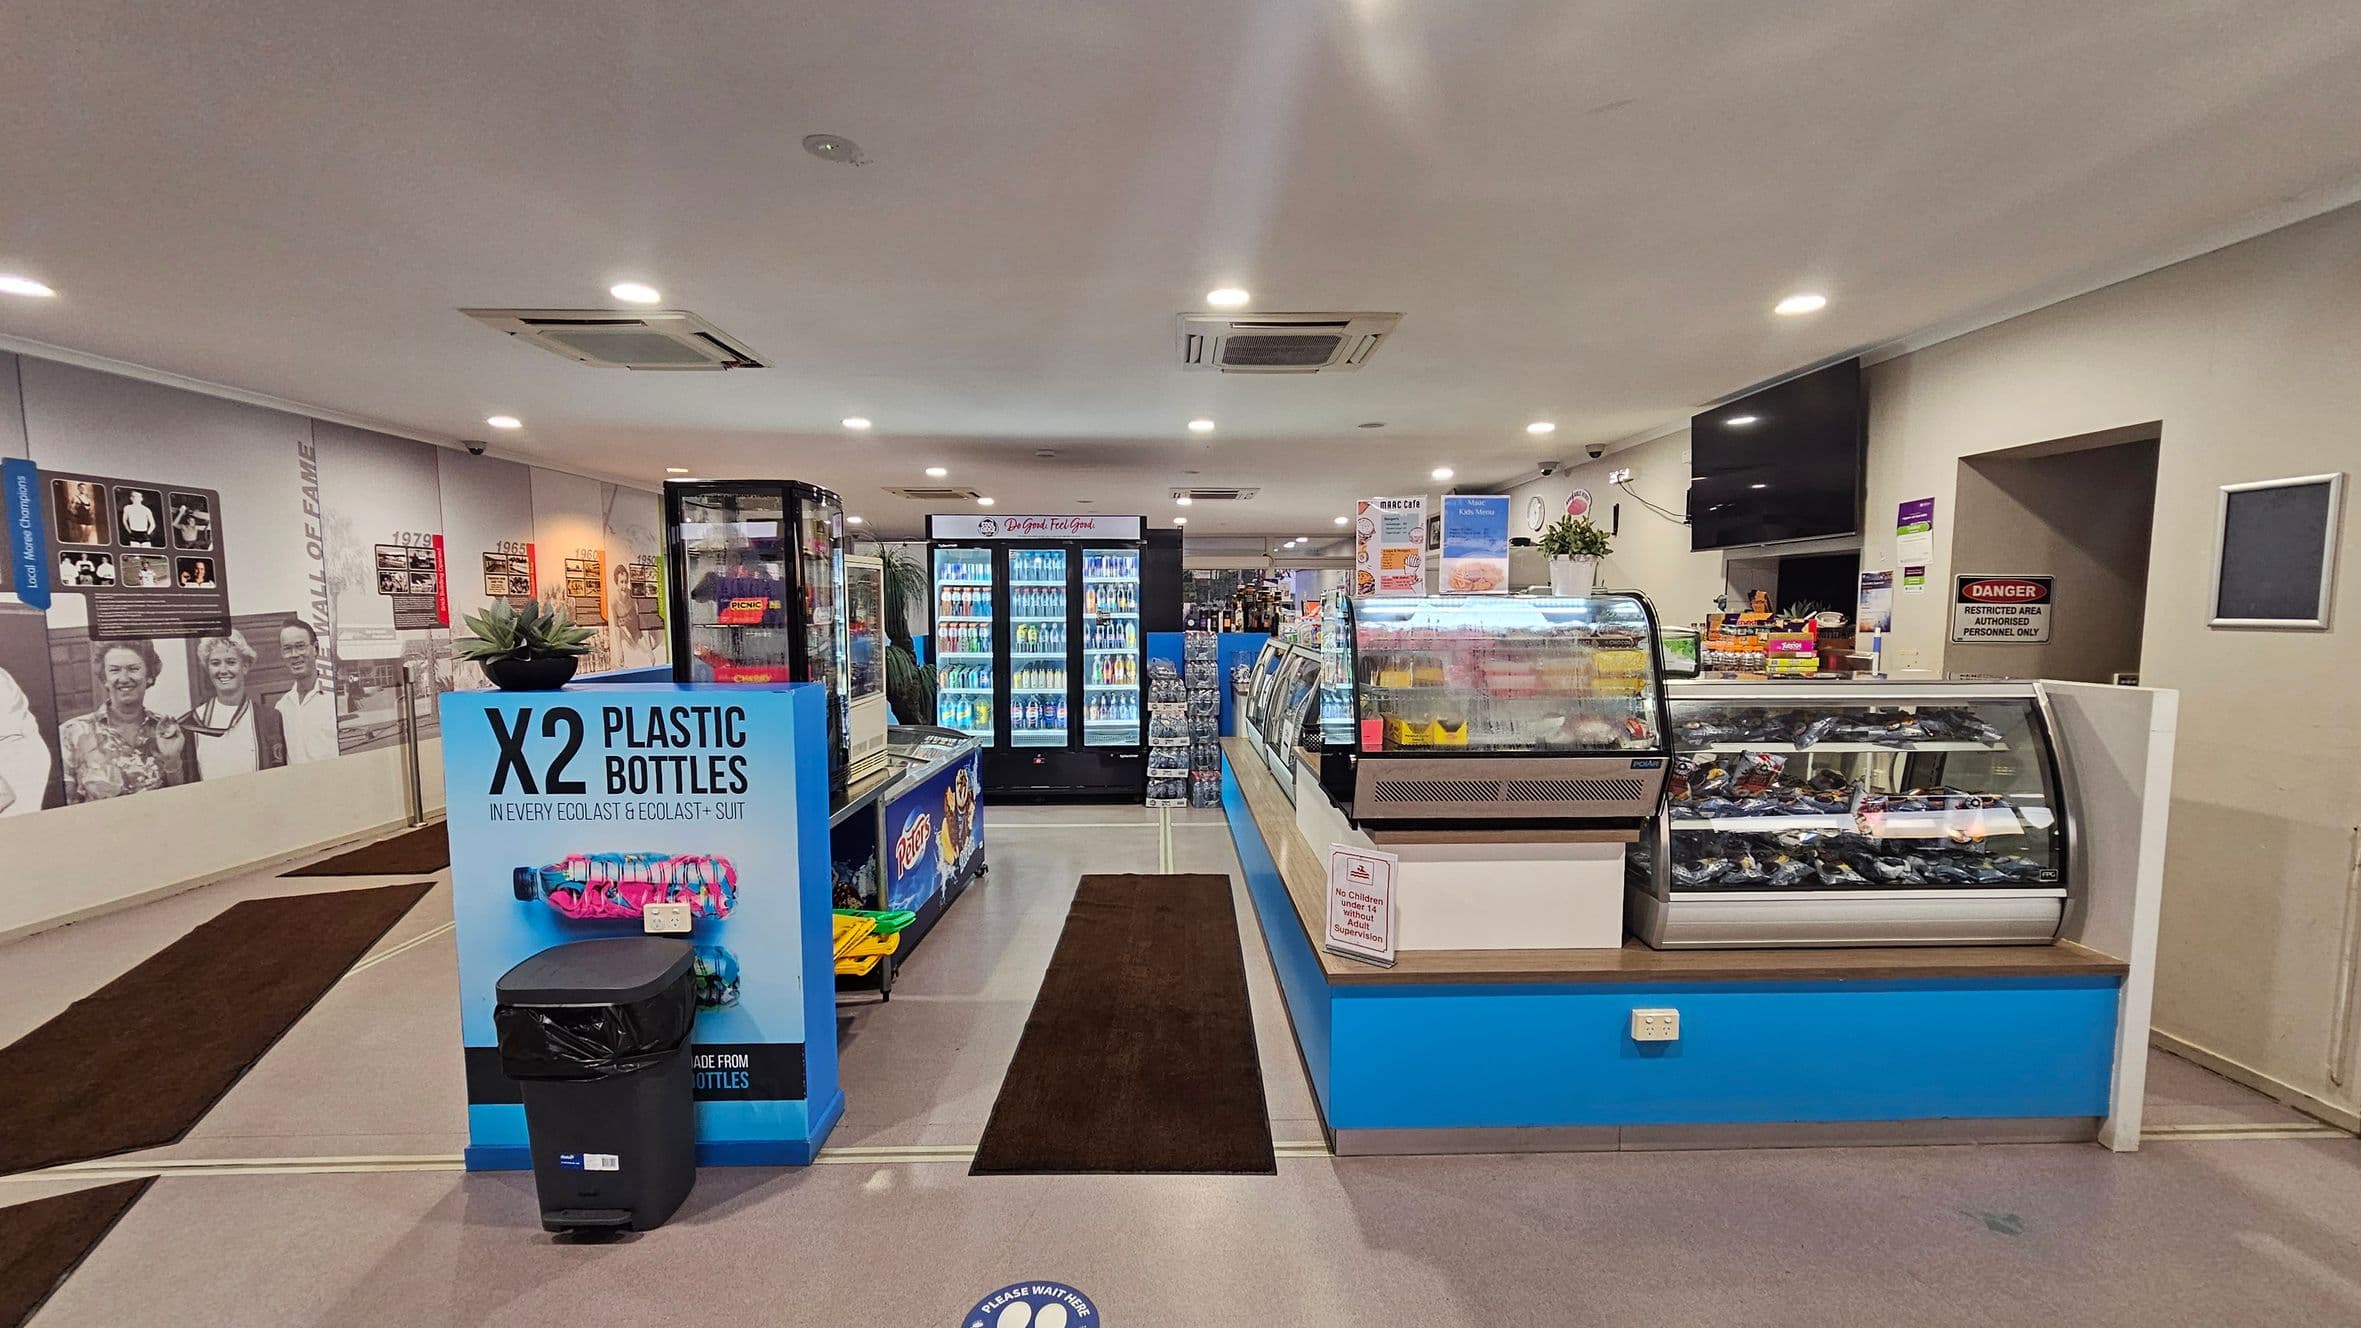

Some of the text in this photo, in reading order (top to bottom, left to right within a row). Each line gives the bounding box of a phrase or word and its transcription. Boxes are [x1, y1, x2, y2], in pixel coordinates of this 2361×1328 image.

[1458, 508, 1495, 516] Kids Menu
[19, 475, 40, 589] Local Moree Champions
[1004, 518, 1022, 532] Do
[1050, 518, 1069, 531] Feel
[392, 530, 433, 547] 1979
[495, 540, 527, 555] 1965
[575, 548, 598, 560] 1960
[297, 441, 334, 692] THE WALL OF FAME
[436, 547, 444, 572] Opened
[637, 554, 657, 564] 1950
[438, 573, 446, 597] Building
[1972, 585, 2036, 597] DANGER
[731, 601, 762, 609] PICNIC
[1964, 606, 2042, 615] RESTRICTED AREA
[1974, 617, 2030, 626] AUTHORISED
[1963, 628, 2040, 637] PERSONNEL ONLY
[602, 706, 746, 748] PLASTIC
[483, 706, 587, 795] X2
[605, 755, 749, 794] BOTTLES
[490, 801, 746, 821] IN EVERY ECOLAST & ECOLAST+ SUIT
[2042, 871, 2056, 879] FPG
[1335, 888, 1384, 906] No Children
[1341, 900, 1377, 913] under 14
[1343, 909, 1374, 922] without
[1347, 919, 1370, 931] Adult
[1334, 924, 1383, 943] Supervision
[717, 1054, 749, 1069] FROM
[981, 1286, 1091, 1318] PLEASE WAIT HERE
